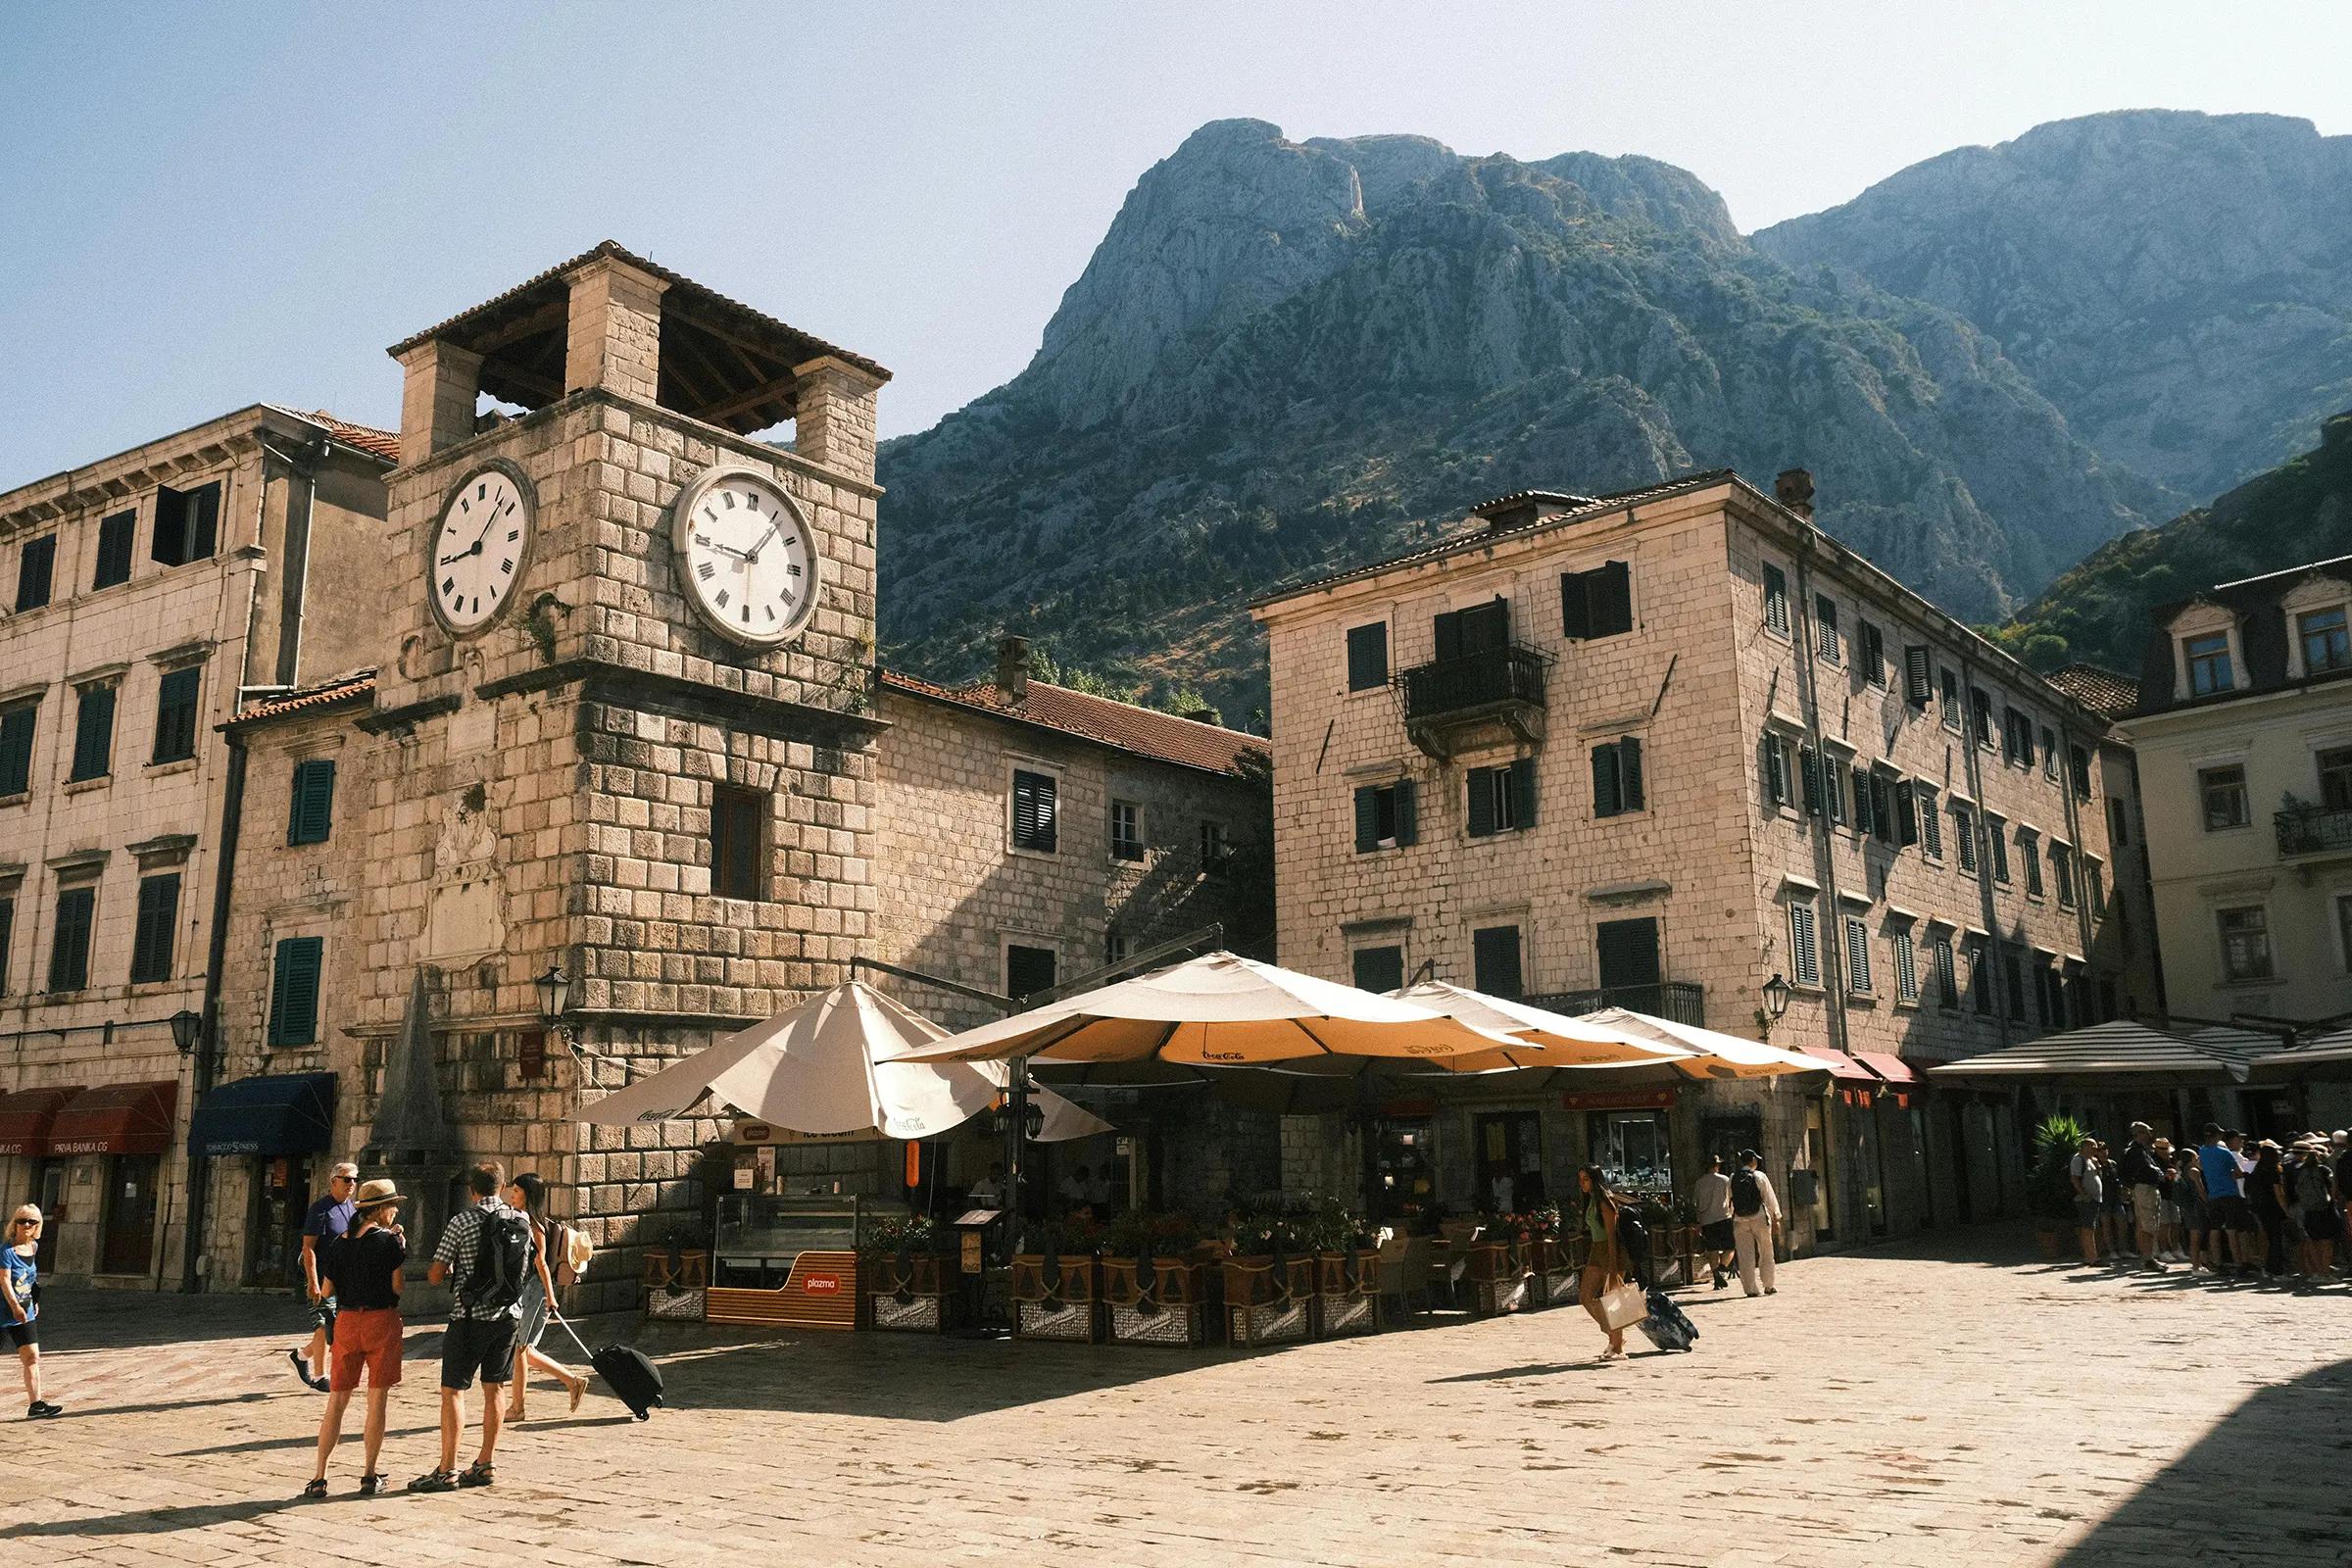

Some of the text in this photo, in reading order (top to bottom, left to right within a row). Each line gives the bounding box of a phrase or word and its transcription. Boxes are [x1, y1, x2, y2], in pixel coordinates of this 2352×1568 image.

[703, 506, 718, 523] X
[770, 510, 779, 523] I
[447, 526, 457, 536] X
[507, 529, 519, 542] III
[694, 533, 711, 547] IX
[784, 536, 796, 547] II
[786, 564, 801, 577] III
[764, 604, 776, 622] V
[11, 1144, 22, 1154] CG
[54, 1141, 108, 1153] PRVA BANKA CG
[807, 1278, 834, 1289] plazma
[1031, 1307, 1076, 1330] SAN GIOVANNI
[1125, 1312, 1171, 1338] SAN GIOVANNI
